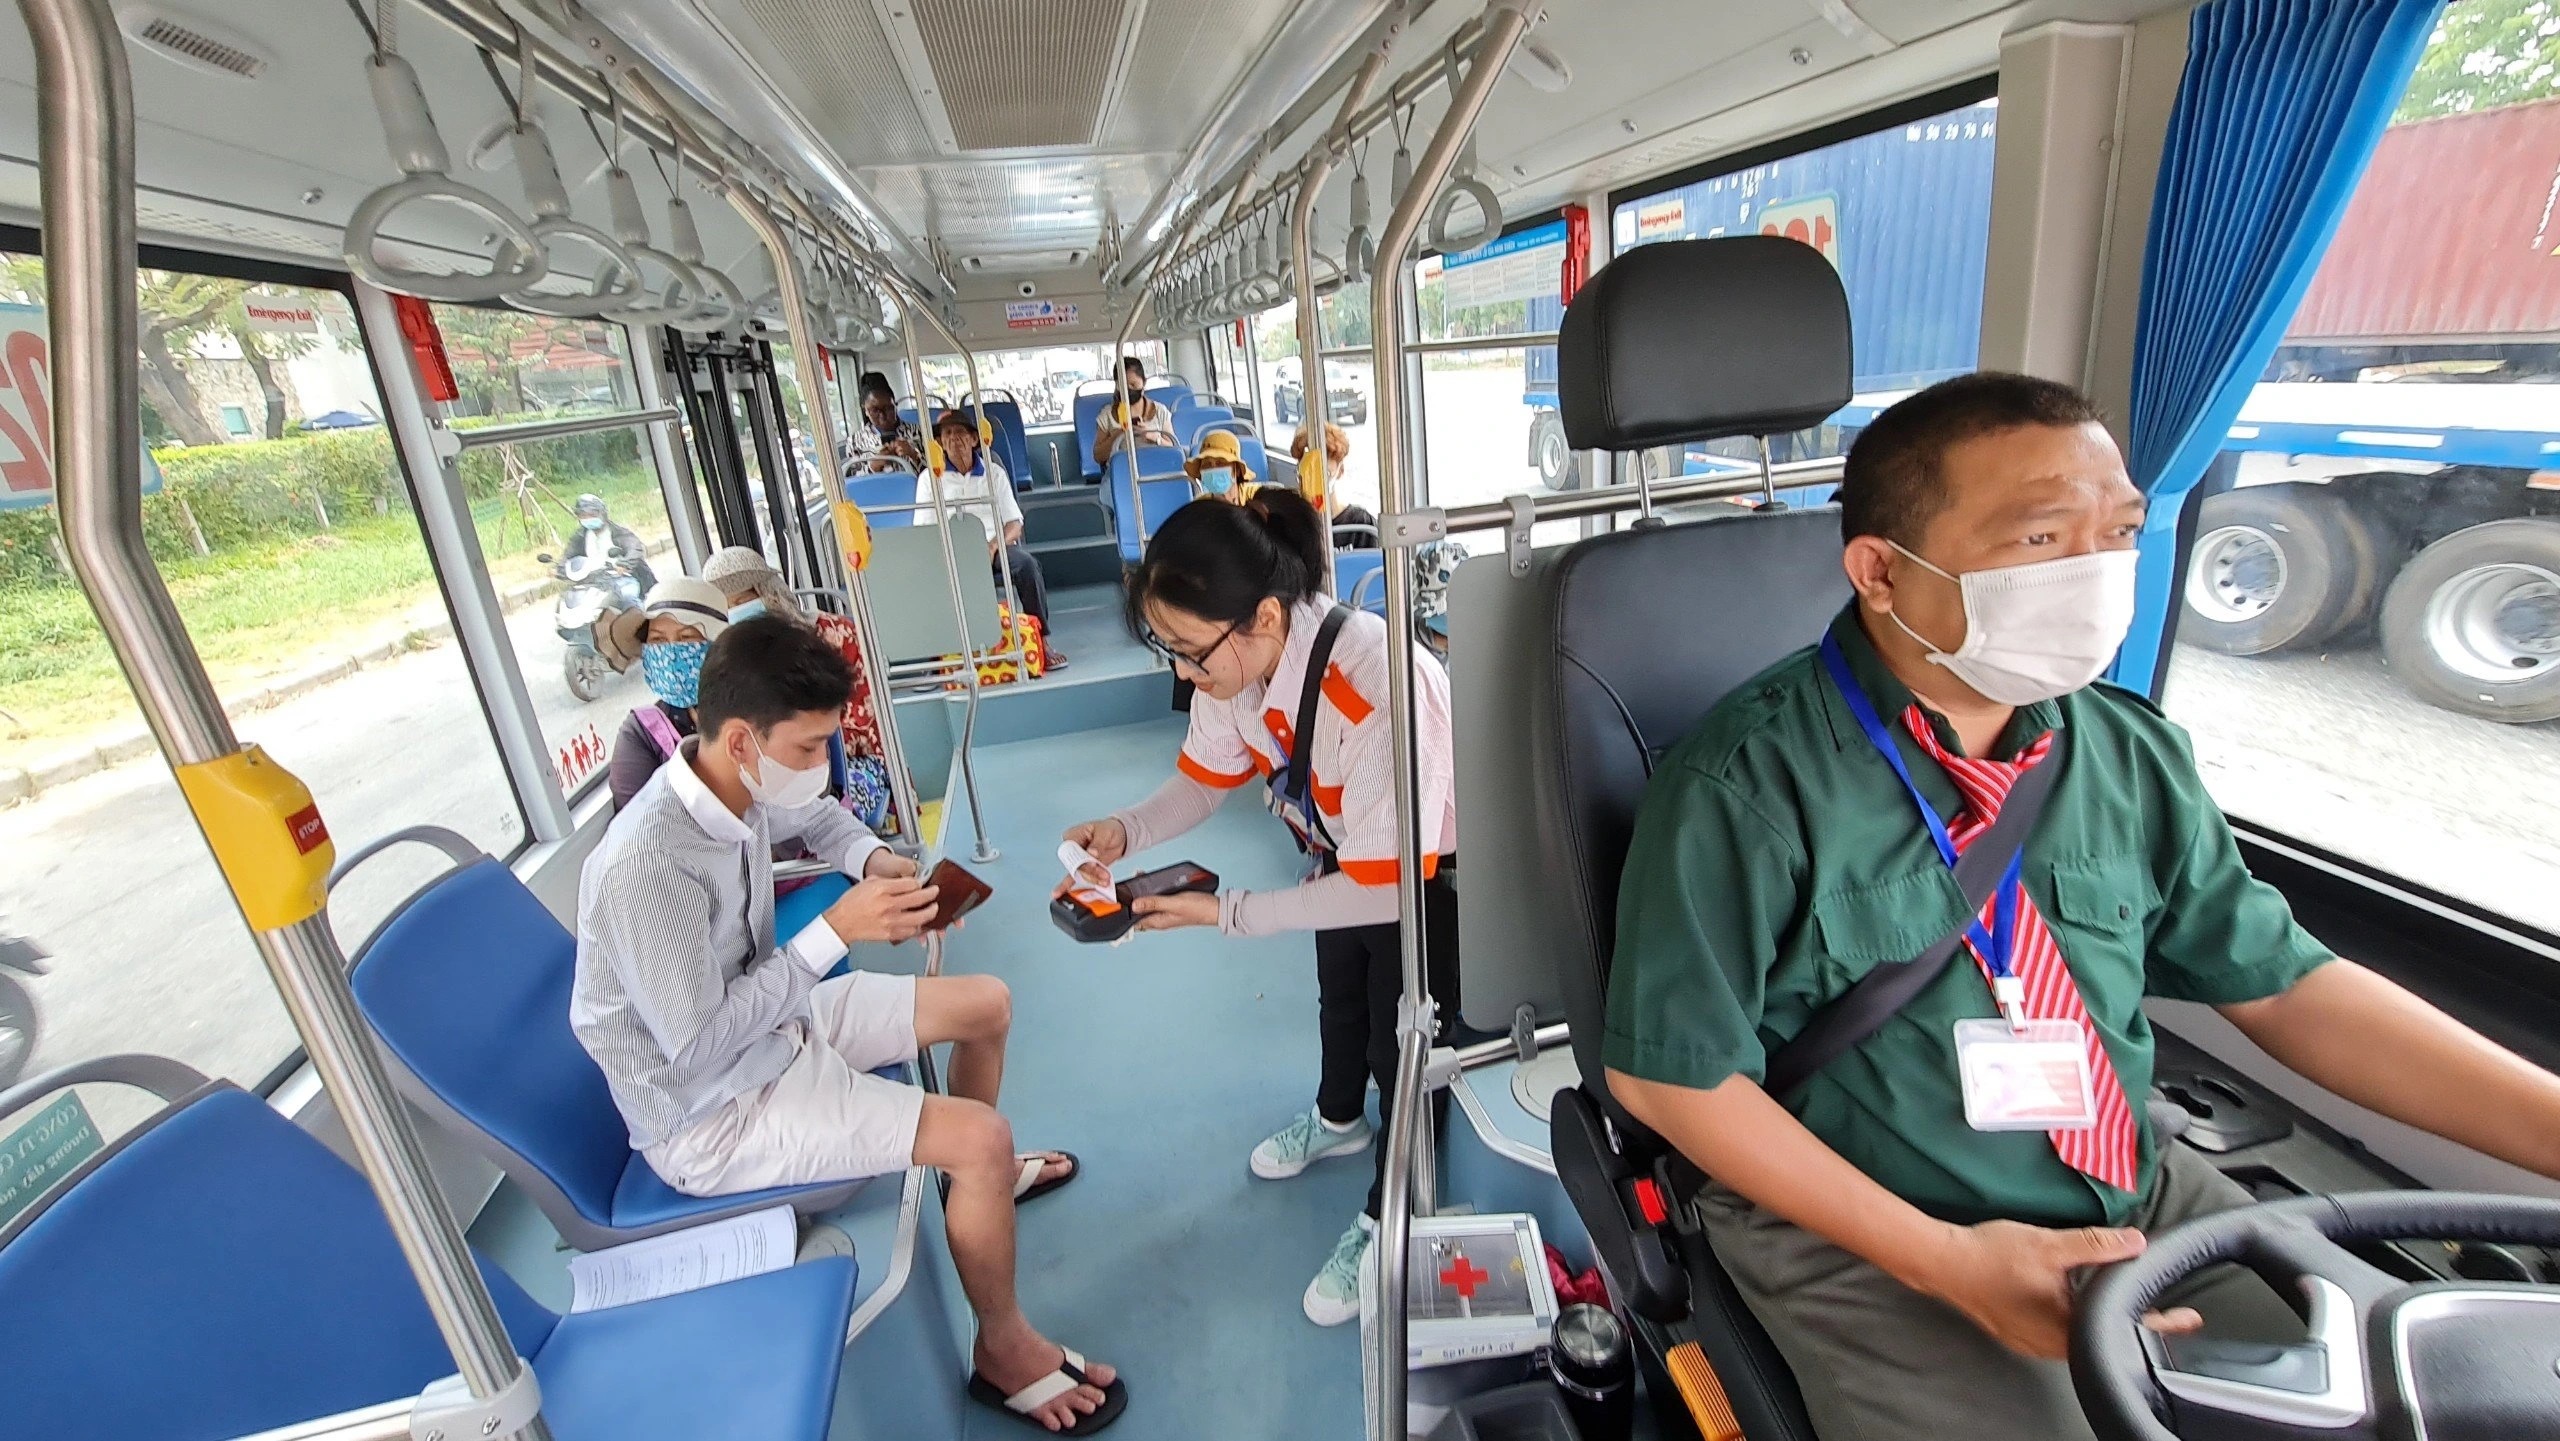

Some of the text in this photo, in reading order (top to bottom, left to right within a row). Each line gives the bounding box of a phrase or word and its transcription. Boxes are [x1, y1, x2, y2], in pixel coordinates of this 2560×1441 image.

[246, 304, 297, 323] Emergency
[295, 308, 313, 321] Exit
[299, 818, 320, 839] STOP
